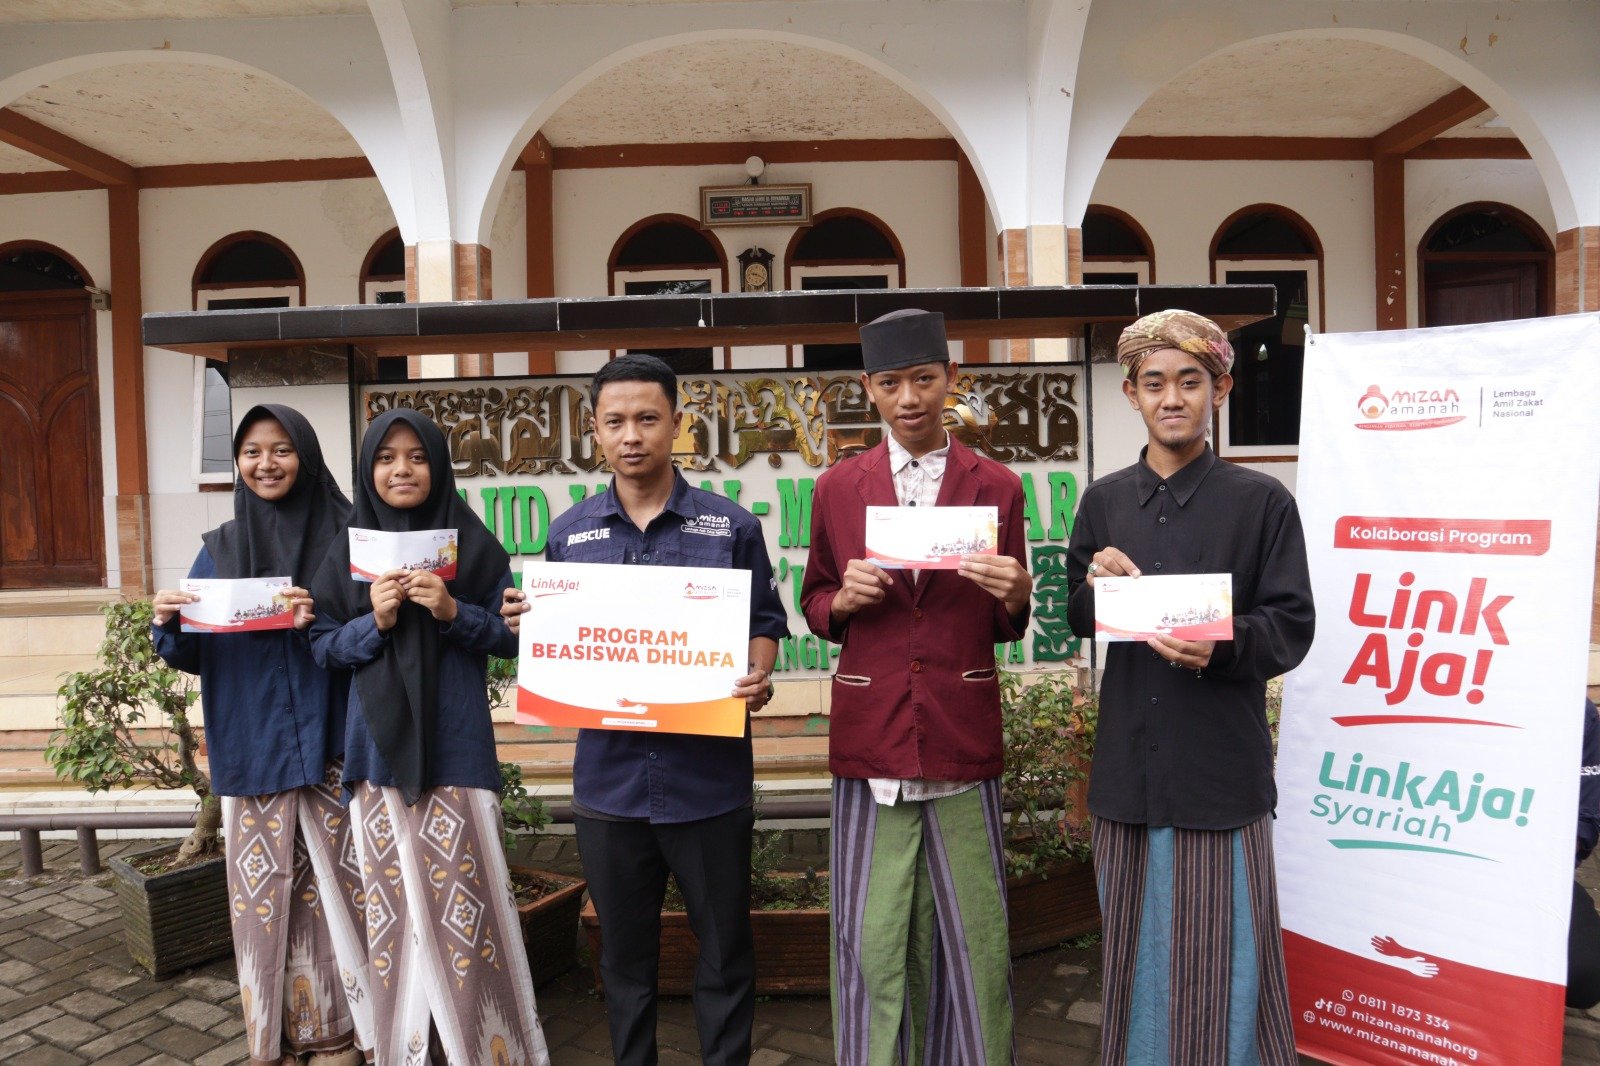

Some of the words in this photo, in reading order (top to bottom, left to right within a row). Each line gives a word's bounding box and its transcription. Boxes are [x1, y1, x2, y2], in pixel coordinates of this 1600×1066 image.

[1391, 388, 1459, 403] mizan
[1493, 389, 1536, 399] Lembaga
[1493, 399, 1514, 408] Amil
[1517, 398, 1543, 407] Zakat
[1390, 402, 1459, 415] amanah
[1493, 409, 1534, 418] Nasional
[699, 514, 731, 524] mizan
[567, 527, 611, 547] RESCUE
[1350, 526, 1445, 542] Kolaborasi
[1449, 529, 1532, 548] Program
[531, 578, 580, 592] LinkAja!
[1348, 571, 1515, 646] Link
[578, 627, 688, 646] PROGRAM
[531, 642, 640, 663] BEASISWA
[646, 648, 735, 668] DHUAFA
[1342, 632, 1494, 706] Aja!
[1318, 751, 1536, 827] LinkAja!
[1309, 794, 1452, 842] Syariah
[1358, 993, 1387, 1012] 0811
[1390, 1002, 1422, 1022] 1873
[1425, 1013, 1451, 1031] 334
[1351, 1008, 1479, 1060] mizanamanahorg
